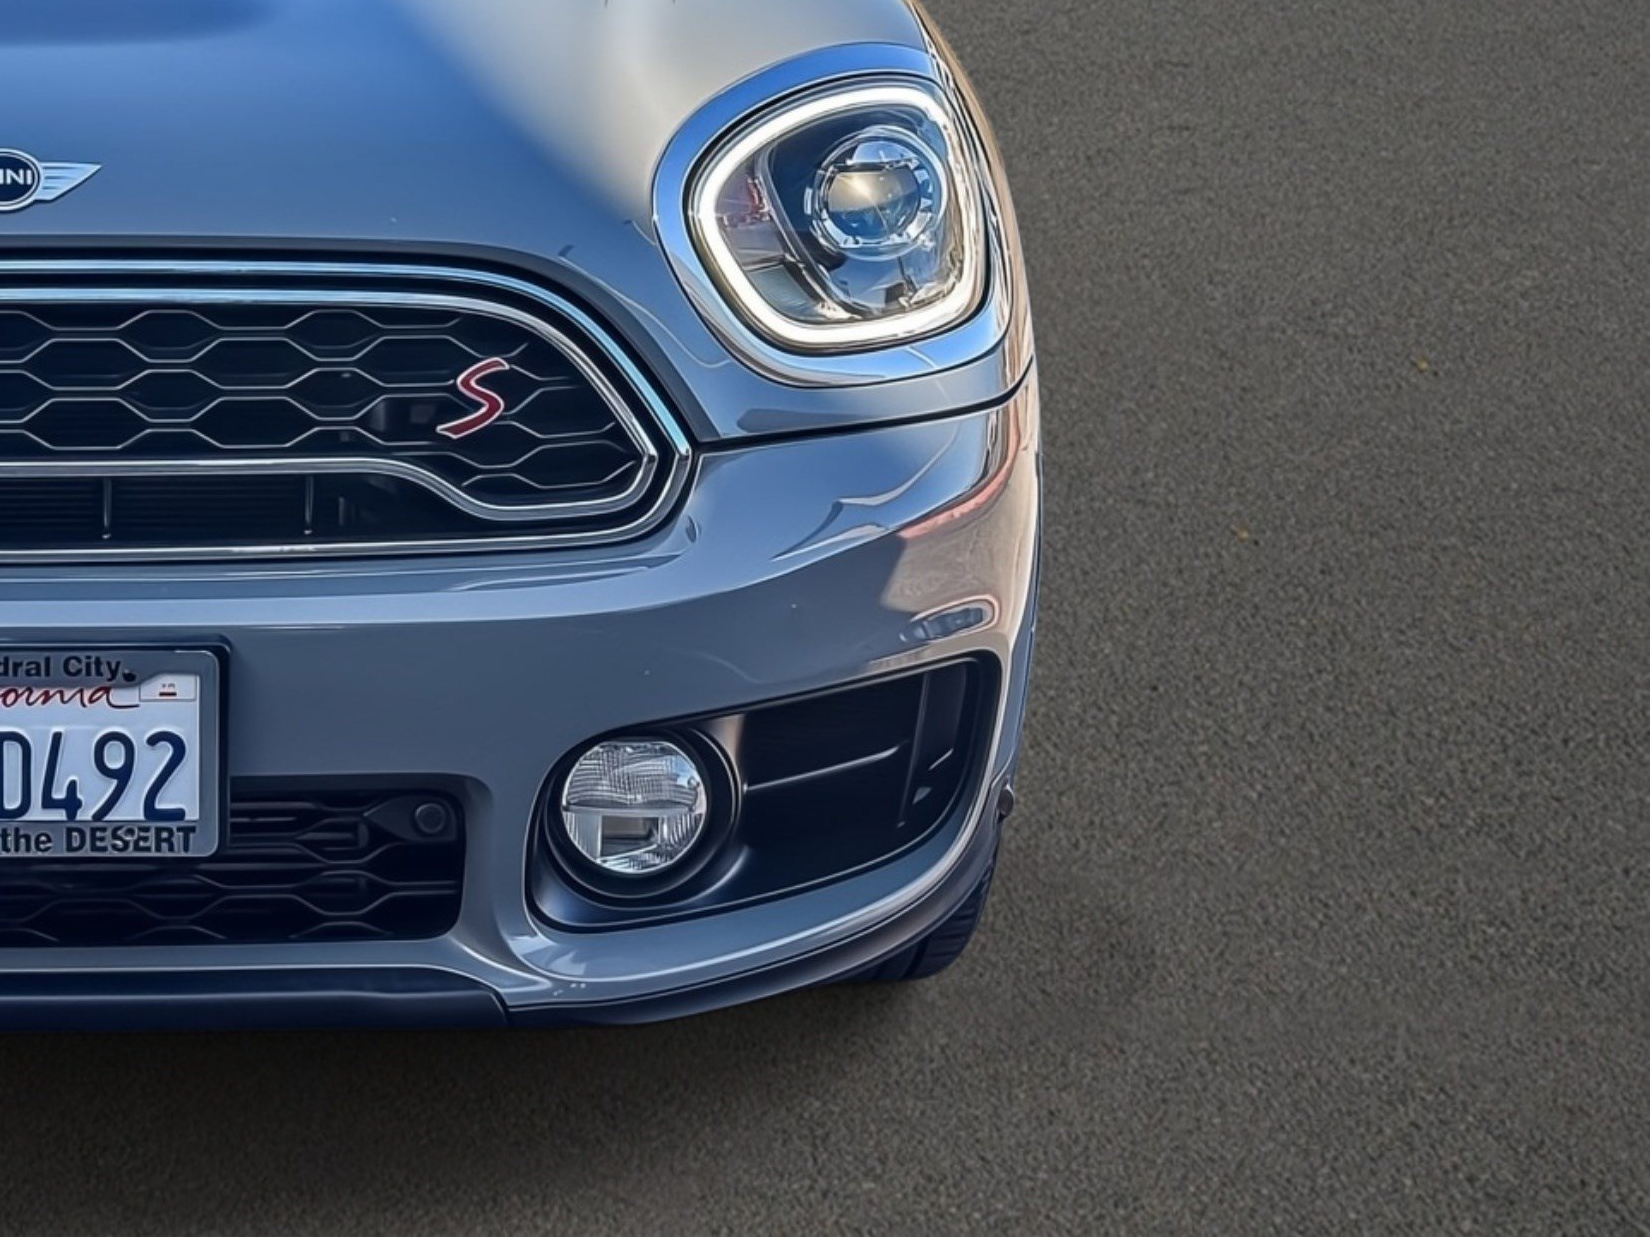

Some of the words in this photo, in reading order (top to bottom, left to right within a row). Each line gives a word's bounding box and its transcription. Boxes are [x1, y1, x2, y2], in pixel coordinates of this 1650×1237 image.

[435, 357, 510, 439] S
[63, 655, 122, 682] City
[0, 826, 53, 854] the
[65, 825, 197, 854] DESERT
